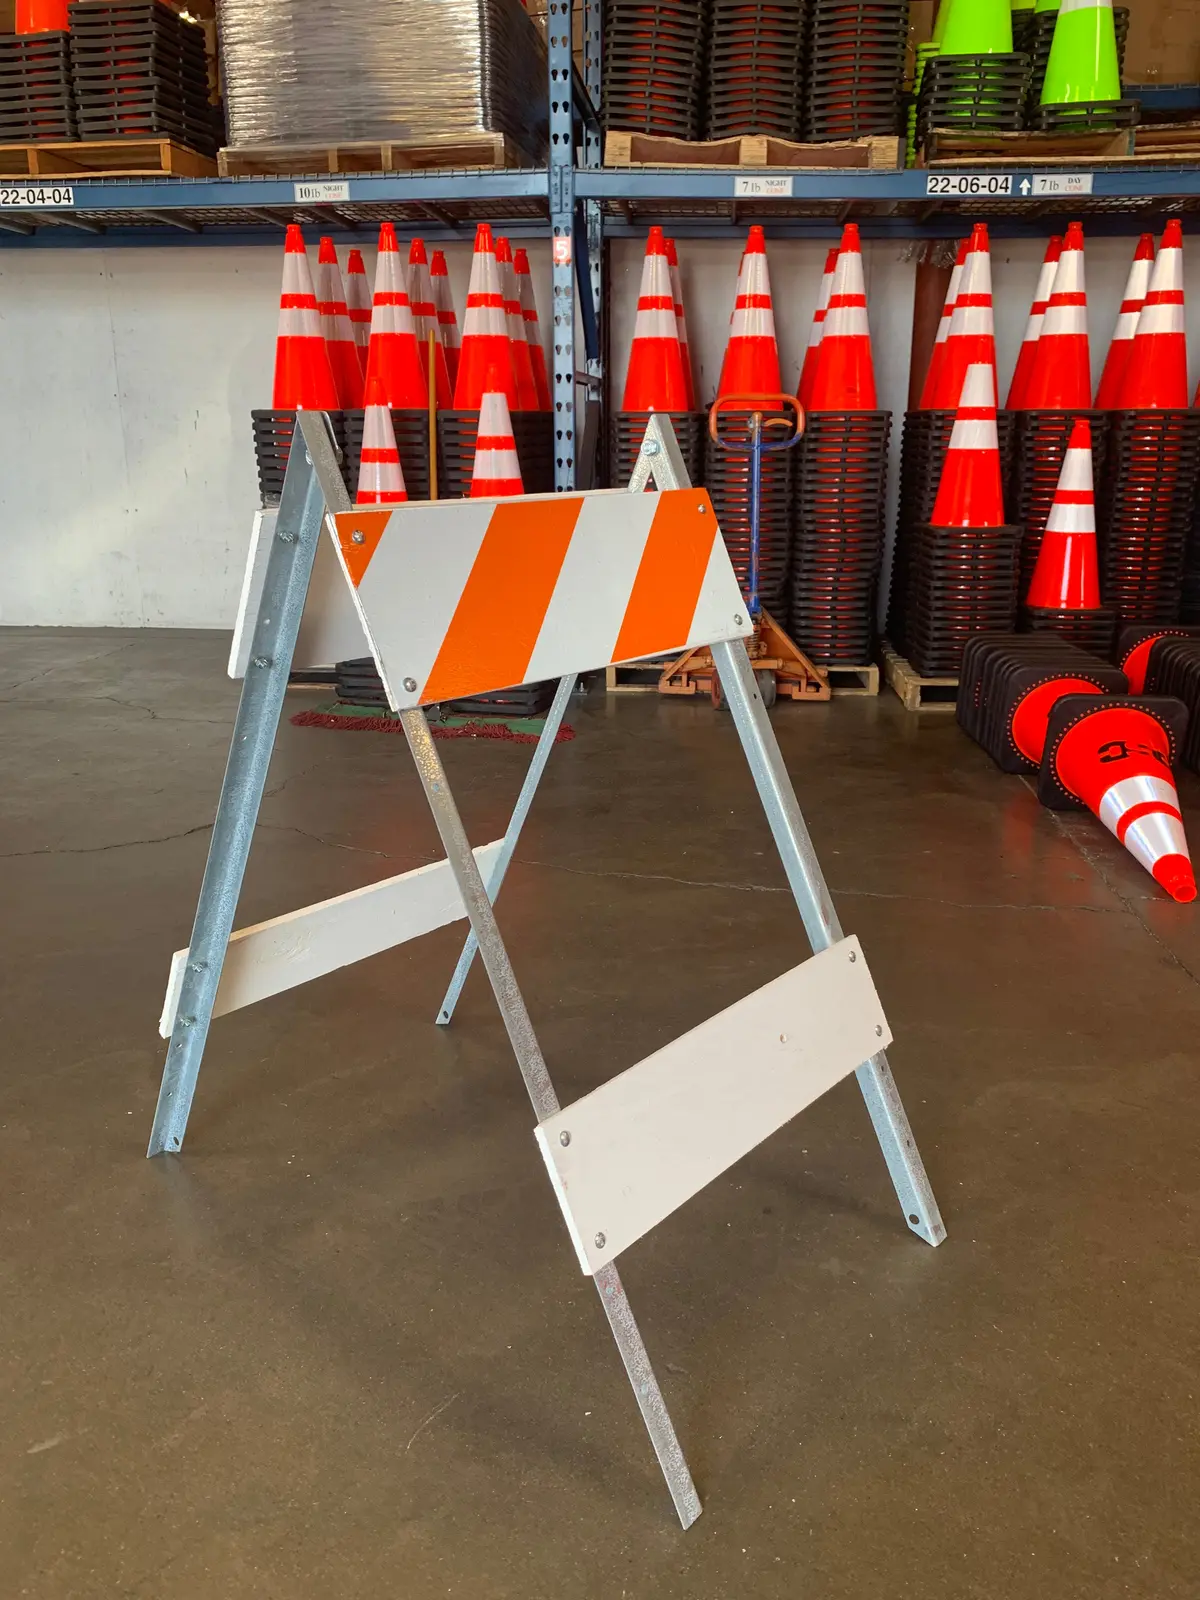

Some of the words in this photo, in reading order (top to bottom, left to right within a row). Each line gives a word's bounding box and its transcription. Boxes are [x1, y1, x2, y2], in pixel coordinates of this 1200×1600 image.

[323, 184, 344, 192] NIGHT
[742, 181, 749, 193] 7
[765, 179, 788, 187] NIGHT
[928, 176, 1010, 193] 22-06-04
[1040, 179, 1047, 191] 7
[0, 188, 72, 204] 22-04-04
[556, 240, 569, 260] 5
